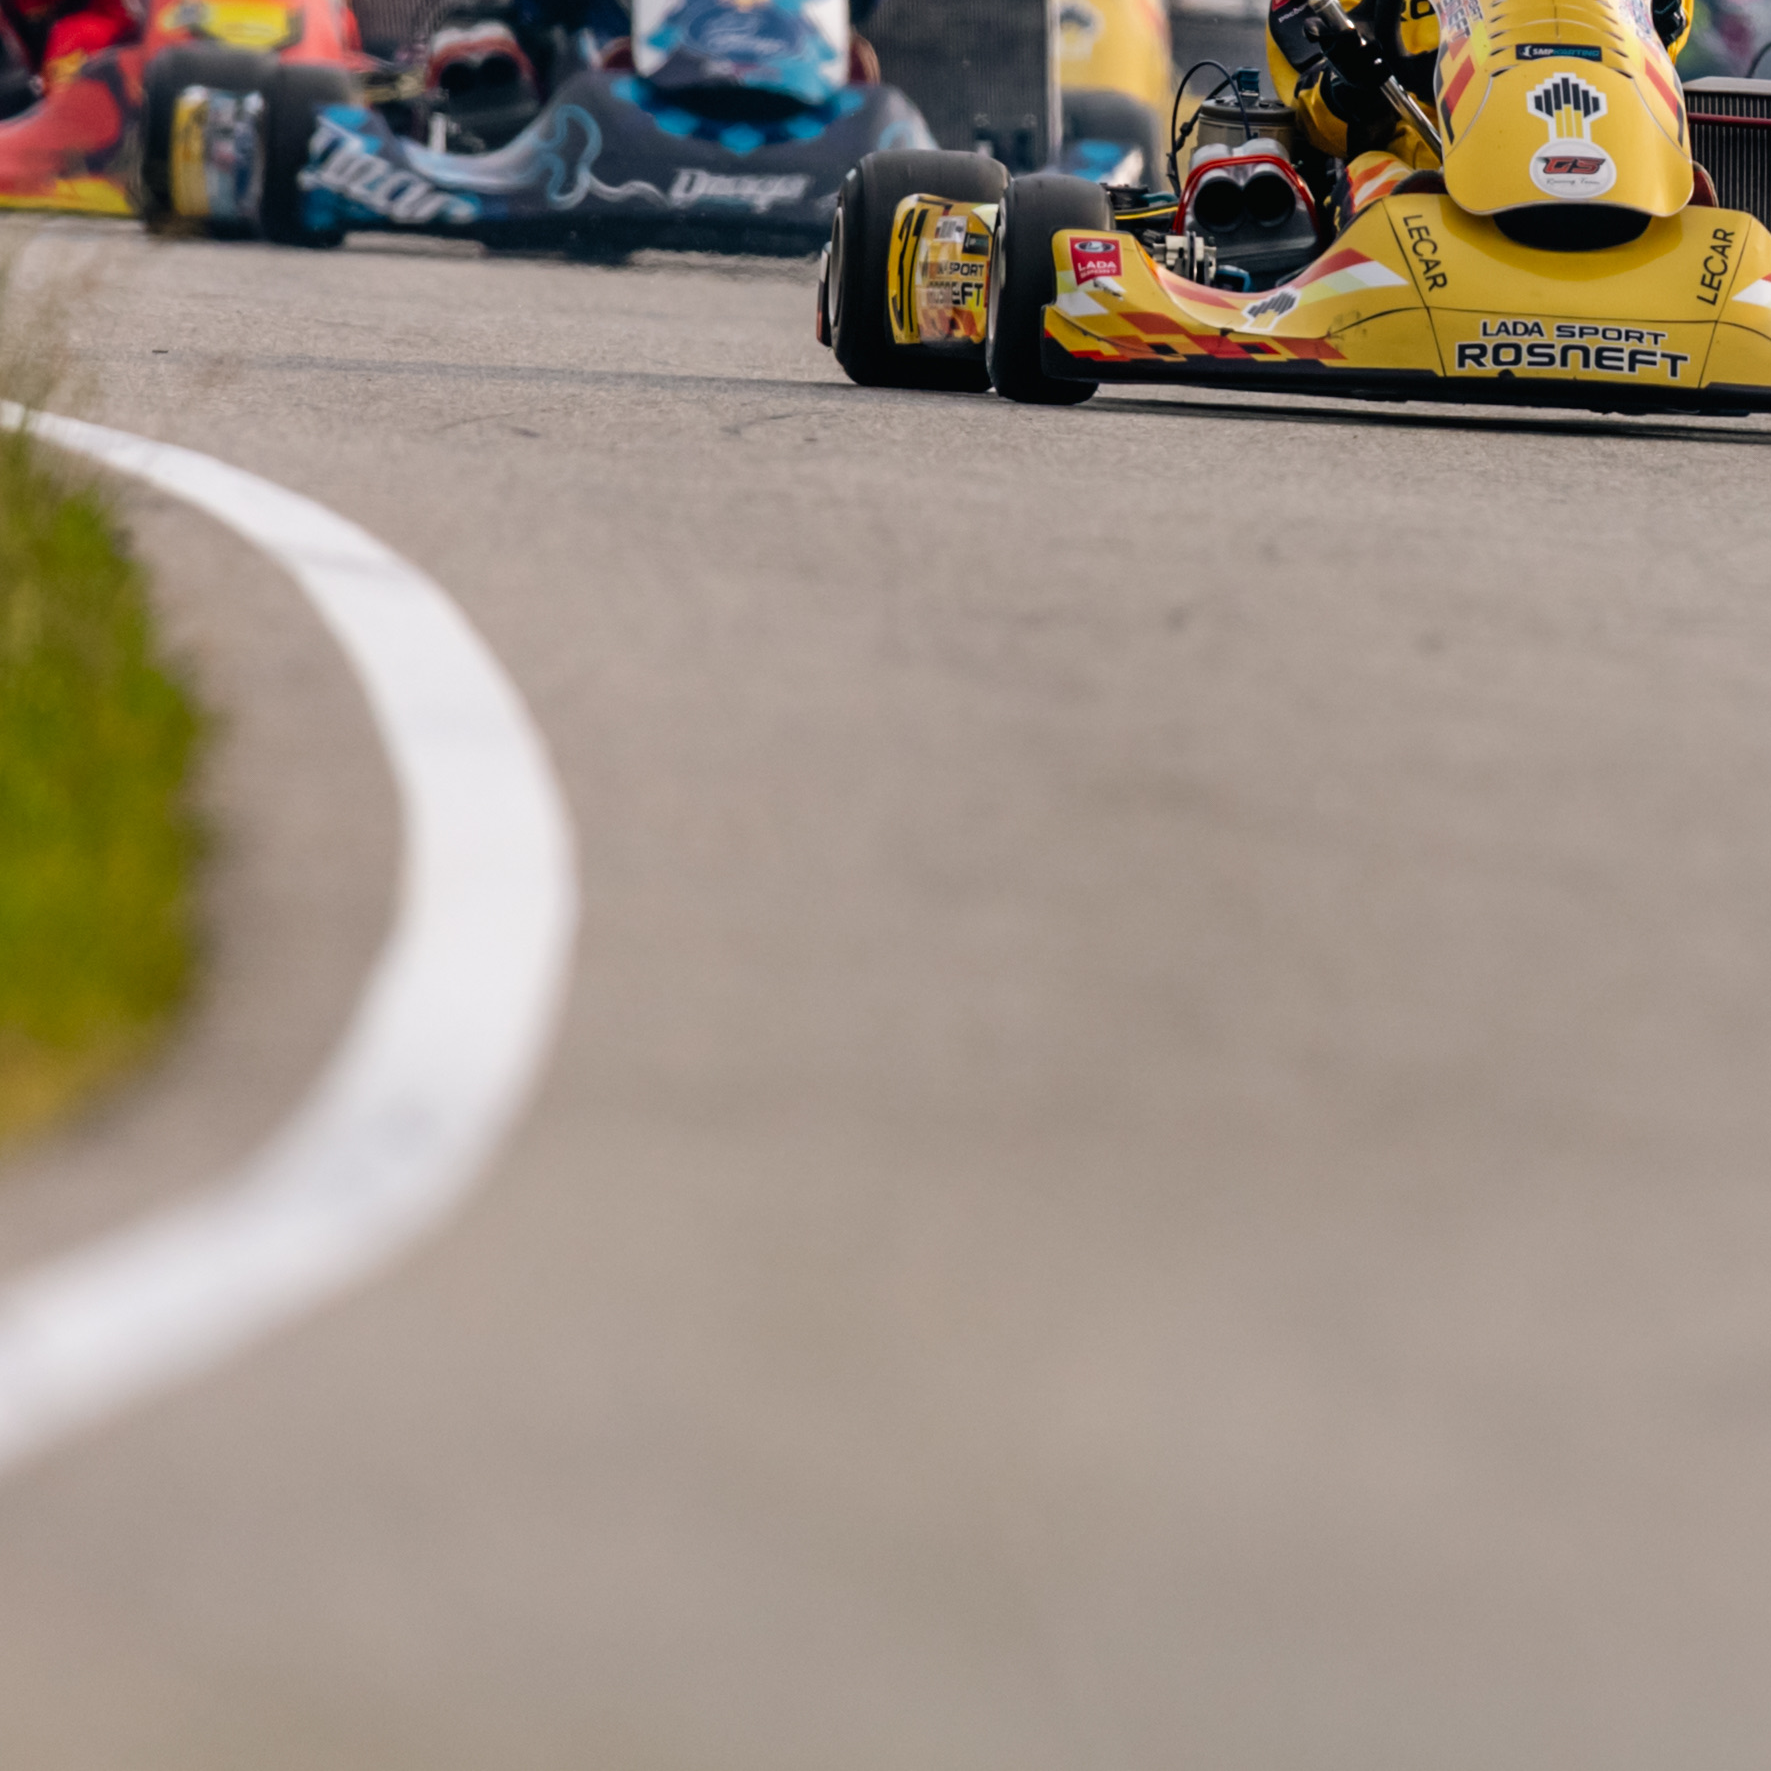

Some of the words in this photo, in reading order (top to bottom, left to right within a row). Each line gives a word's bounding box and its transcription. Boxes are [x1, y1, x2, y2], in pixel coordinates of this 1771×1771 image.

[1077, 259, 1118, 273] LADA
[1403, 213, 1448, 293] LECAR
[1696, 227, 1736, 307] LECAR
[1481, 320, 1545, 338] LADA
[1555, 323, 1666, 346] SPORT
[1457, 341, 1689, 378] ROSNEFT
